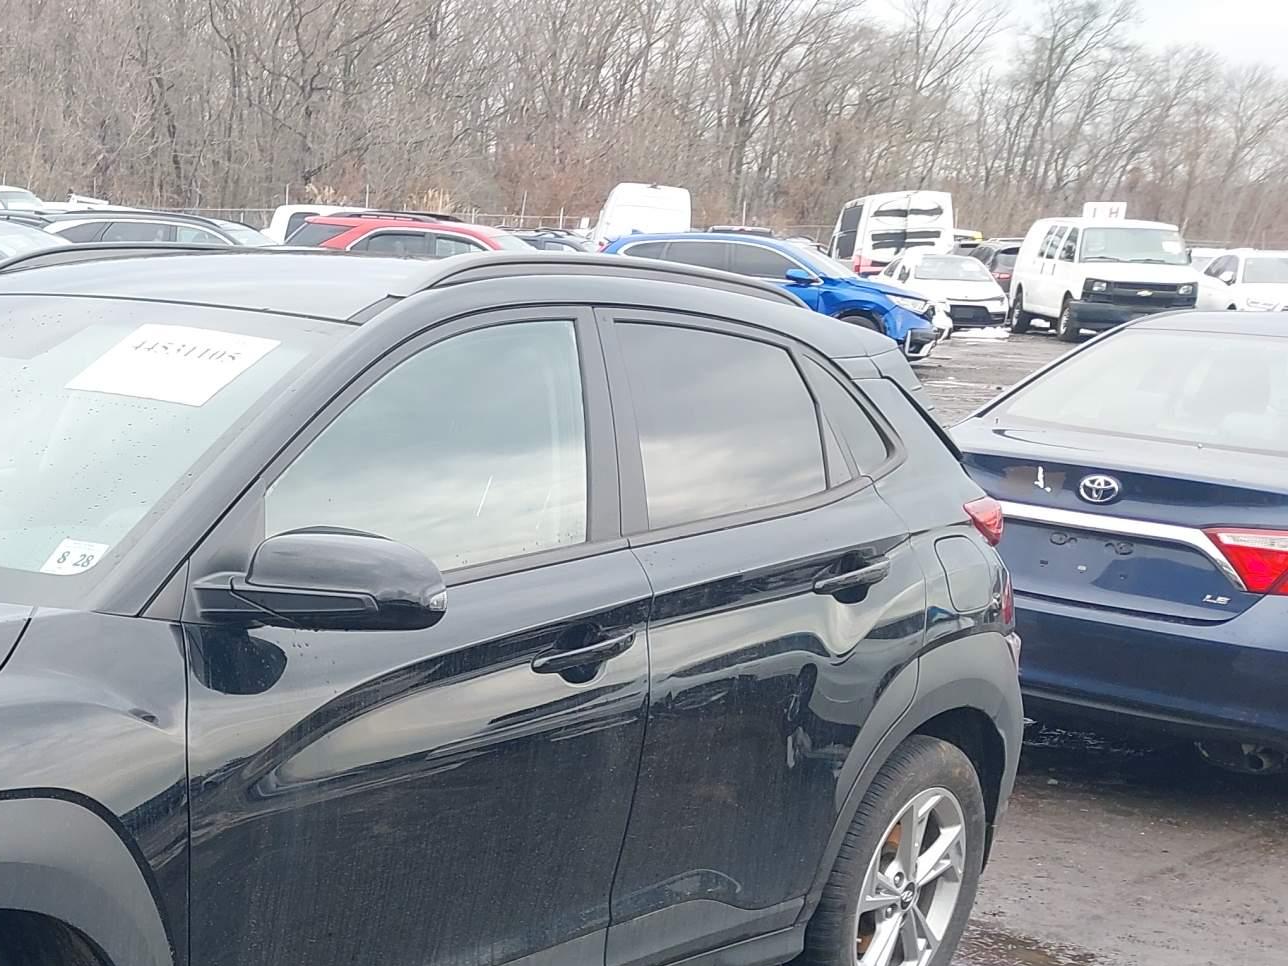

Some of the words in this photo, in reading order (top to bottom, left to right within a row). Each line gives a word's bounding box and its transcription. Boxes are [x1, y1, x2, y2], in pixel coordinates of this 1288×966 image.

[56, 551, 70, 564] 8
[72, 553, 94, 568] 28
[1203, 594, 1231, 605] LE
